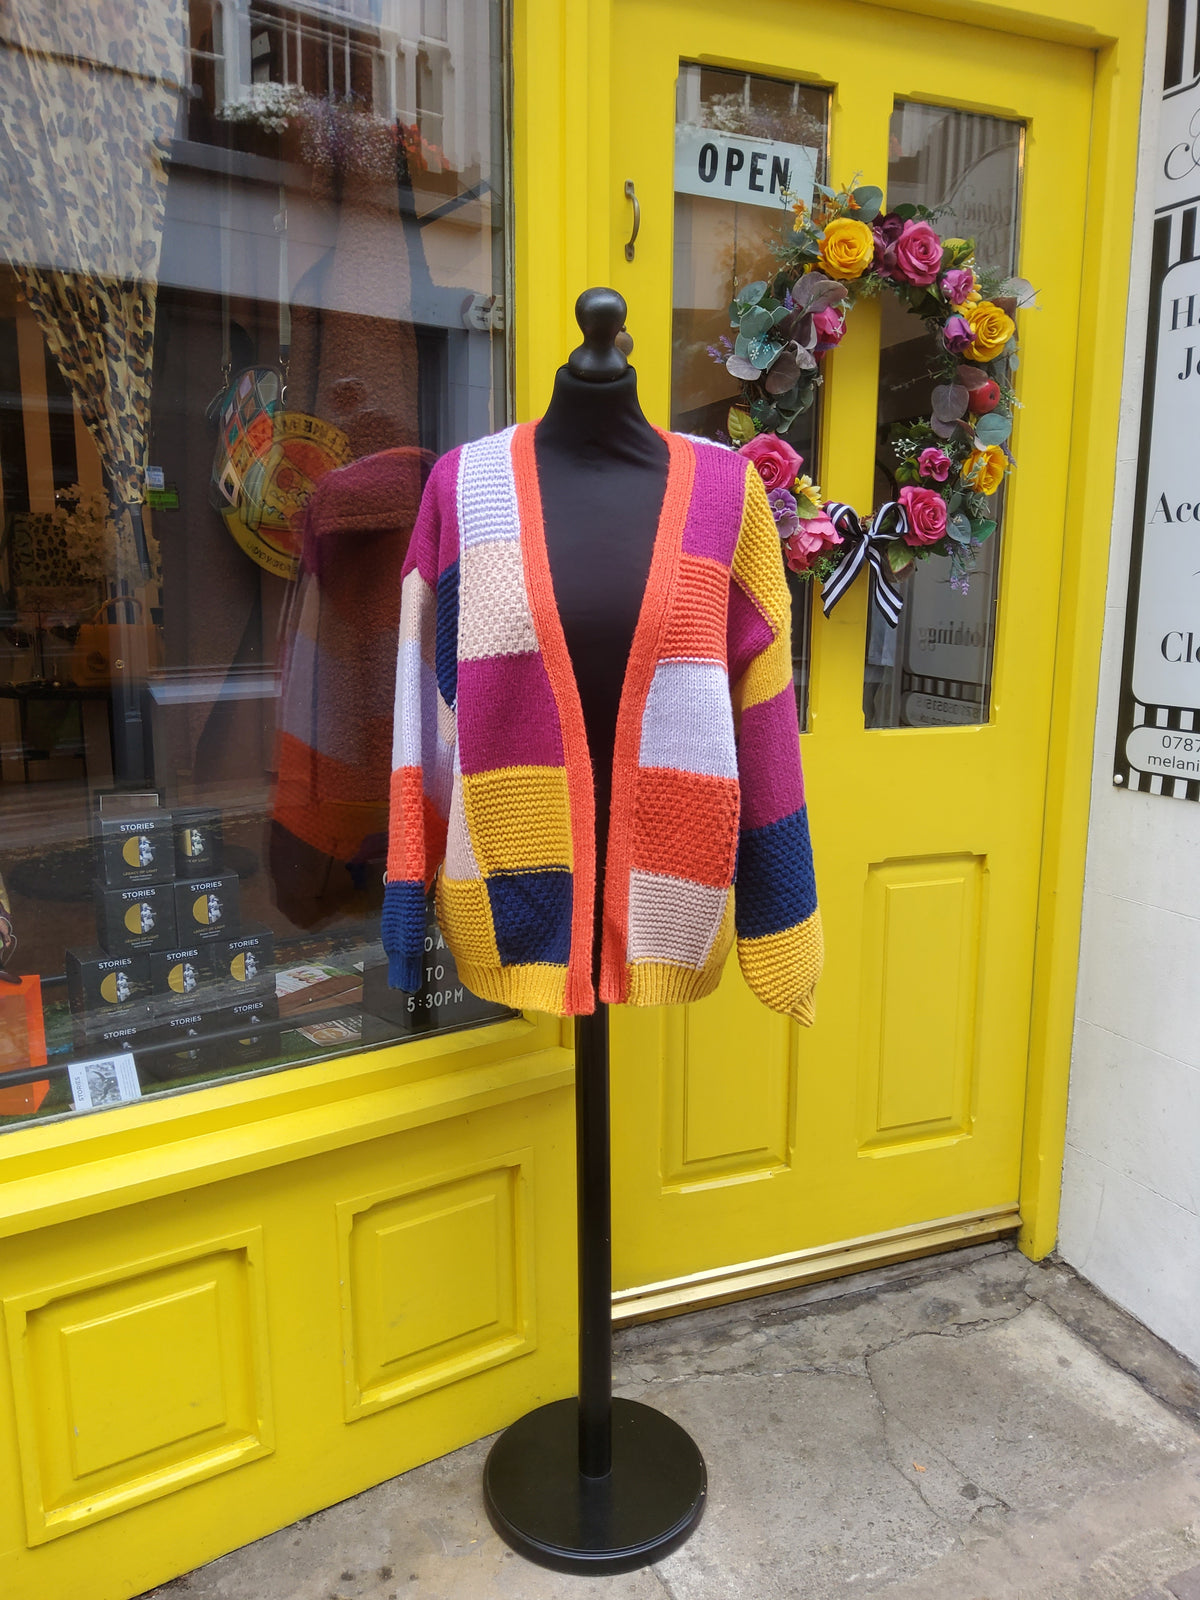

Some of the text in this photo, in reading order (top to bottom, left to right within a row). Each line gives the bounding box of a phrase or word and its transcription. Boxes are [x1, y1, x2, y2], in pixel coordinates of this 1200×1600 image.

[698, 142, 790, 195] OPEN
[120, 822, 155, 832] STORIES
[191, 880, 223, 891] STORIES
[122, 889, 156, 900] STORIES
[229, 938, 259, 949] STORIES
[166, 949, 198, 961] STORIES
[98, 957, 132, 970] STORIES
[426, 964, 445, 982] TO
[406, 986, 464, 1013] 5:30PM
[233, 1001, 264, 1014] STORIES
[170, 1015, 202, 1027] STORIES
[103, 1027, 137, 1040] STORIES
[75, 1076, 84, 1102] STORIES
